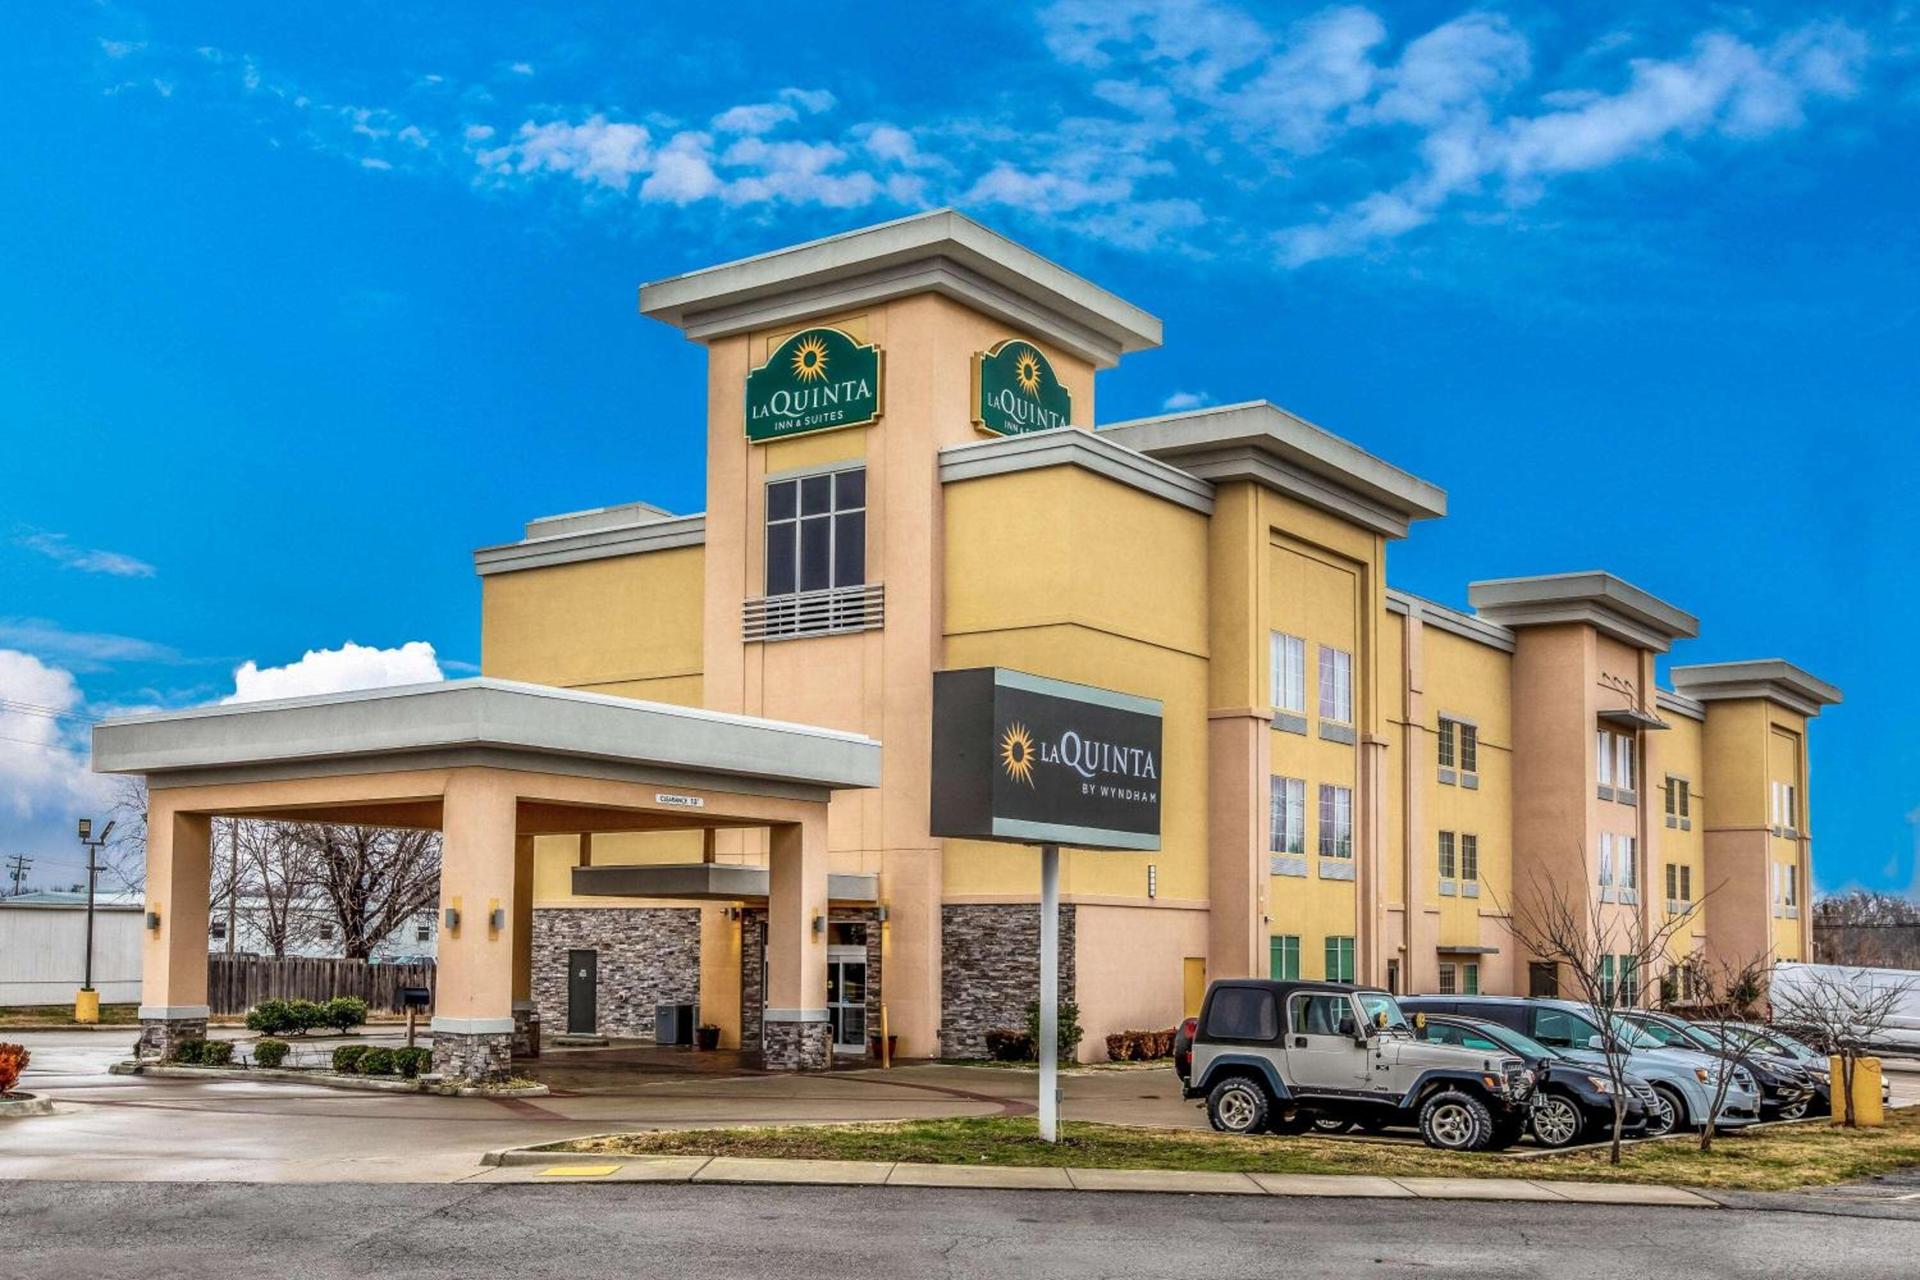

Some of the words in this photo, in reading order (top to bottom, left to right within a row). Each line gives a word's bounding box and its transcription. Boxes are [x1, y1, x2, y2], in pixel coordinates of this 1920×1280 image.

[770, 378, 872, 417] QUINTA
[774, 419, 793, 431] INN
[795, 419, 801, 427] &
[804, 410, 844, 426] SUITES
[1004, 419, 1019, 433] INN
[1060, 731, 1157, 779] QUINTA
[1082, 783, 1096, 795] BY
[1100, 785, 1157, 804] WYNDHAM
